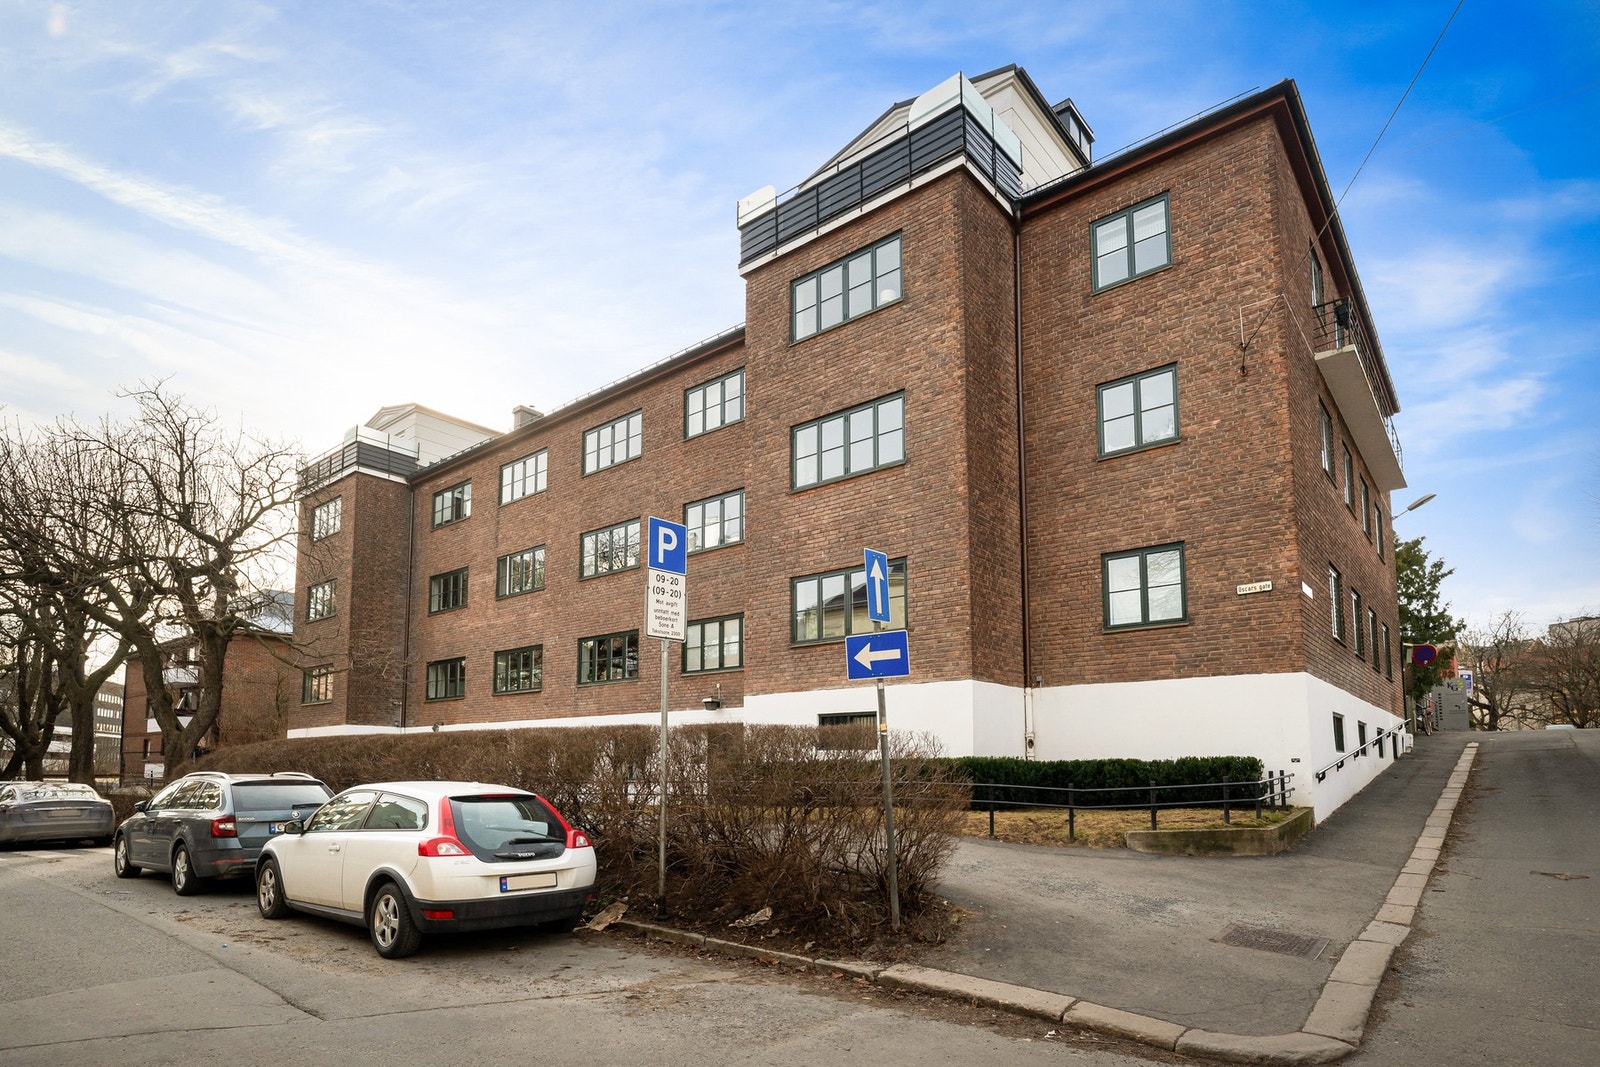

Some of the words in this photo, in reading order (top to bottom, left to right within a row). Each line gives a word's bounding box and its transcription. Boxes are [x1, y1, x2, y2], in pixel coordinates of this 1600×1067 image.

[658, 526, 678, 564] P
[656, 574, 679, 586] 09-20
[652, 585, 682, 599] (09-20)
[1238, 585, 1257, 593] Oscars
[1259, 582, 1271, 591] gate
